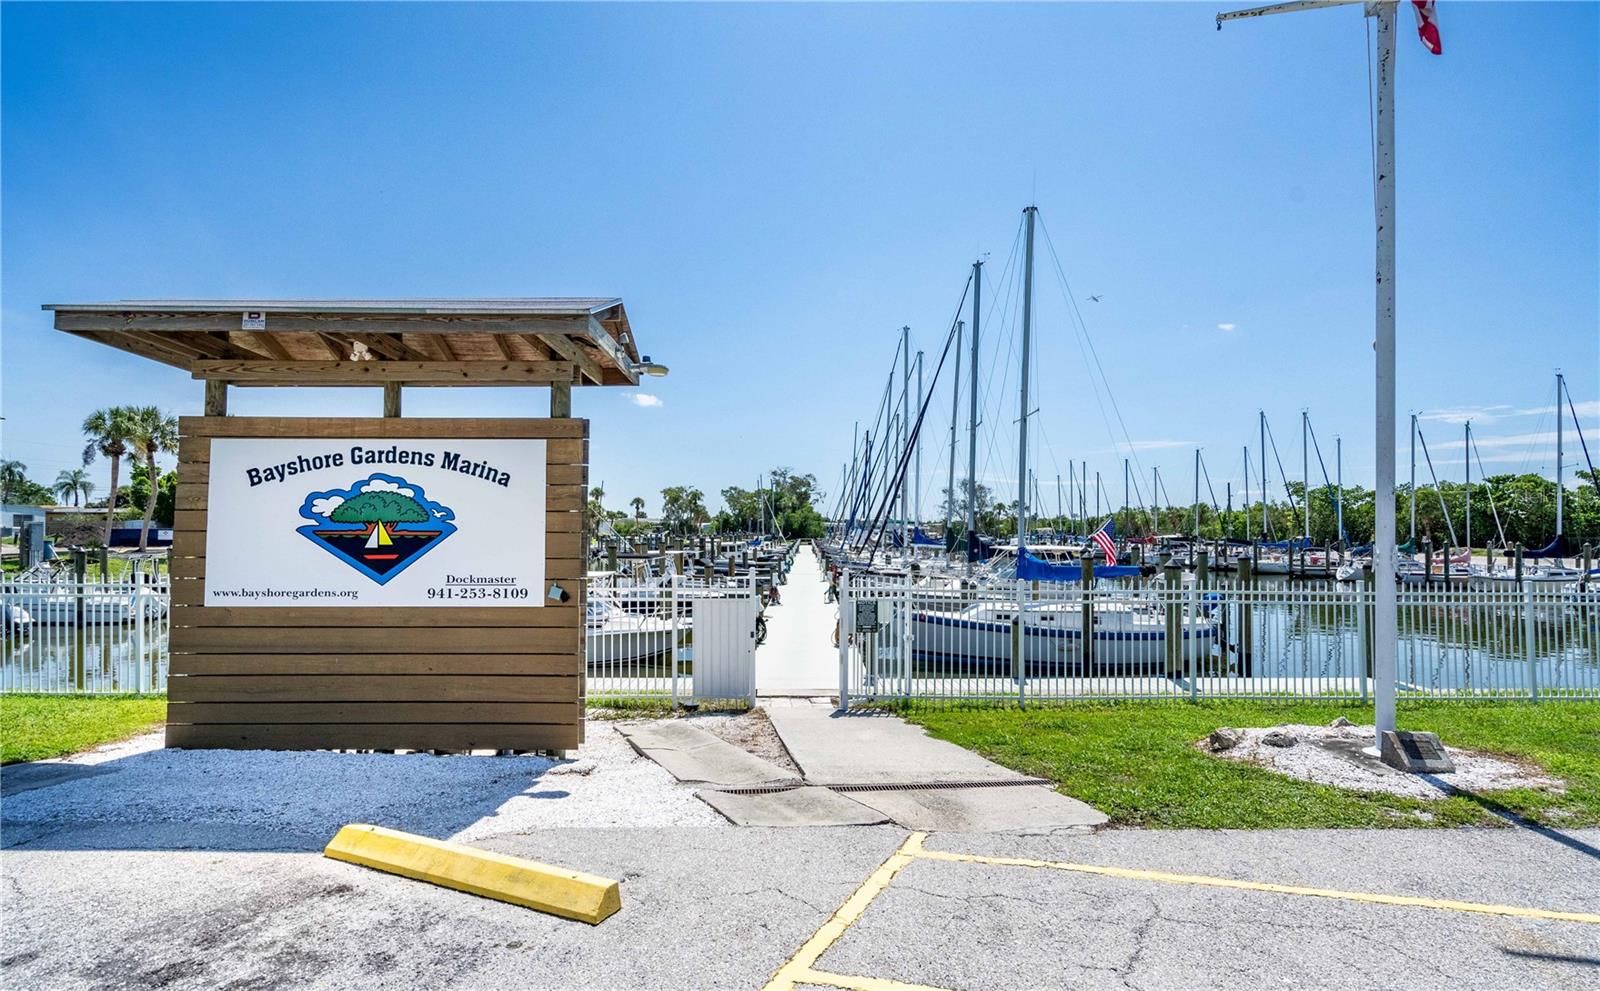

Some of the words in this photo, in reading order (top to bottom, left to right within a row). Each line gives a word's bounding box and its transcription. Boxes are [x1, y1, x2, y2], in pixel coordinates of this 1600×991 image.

[245, 452, 344, 488] Bayshore
[350, 445, 436, 467] Gardens
[440, 450, 511, 488] Marina
[446, 574, 517, 584] Dockmaster
[212, 587, 359, 600] www.bayshoregardens.org
[427, 587, 529, 599] 941-253-8109
